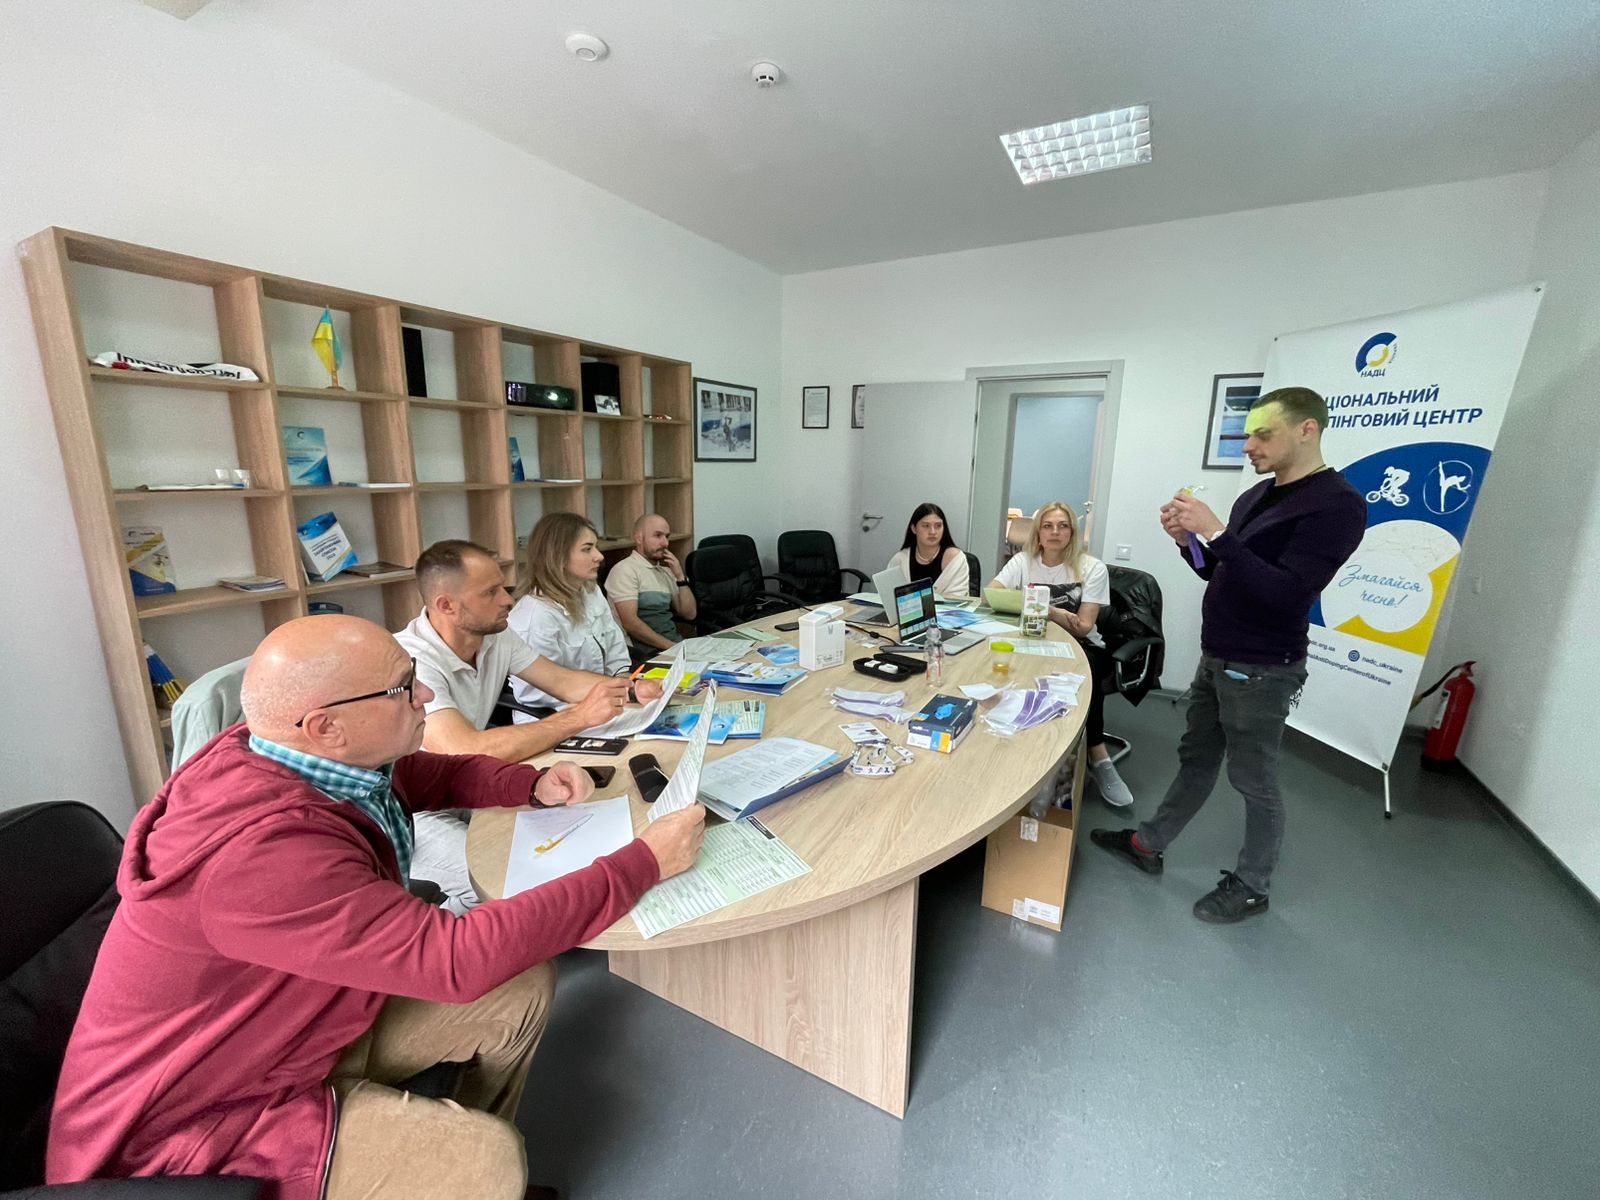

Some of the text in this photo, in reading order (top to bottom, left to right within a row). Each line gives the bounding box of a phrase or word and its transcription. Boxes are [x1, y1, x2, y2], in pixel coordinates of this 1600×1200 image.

[1360, 369, 1386, 378] НАДЦ
[1325, 383, 1440, 412] ЦІОНАЛЬНИЙ
[1327, 408, 1483, 428] ПІНГОВИЙ ЦЕНТР
[1339, 565, 1424, 592] Змагайся
